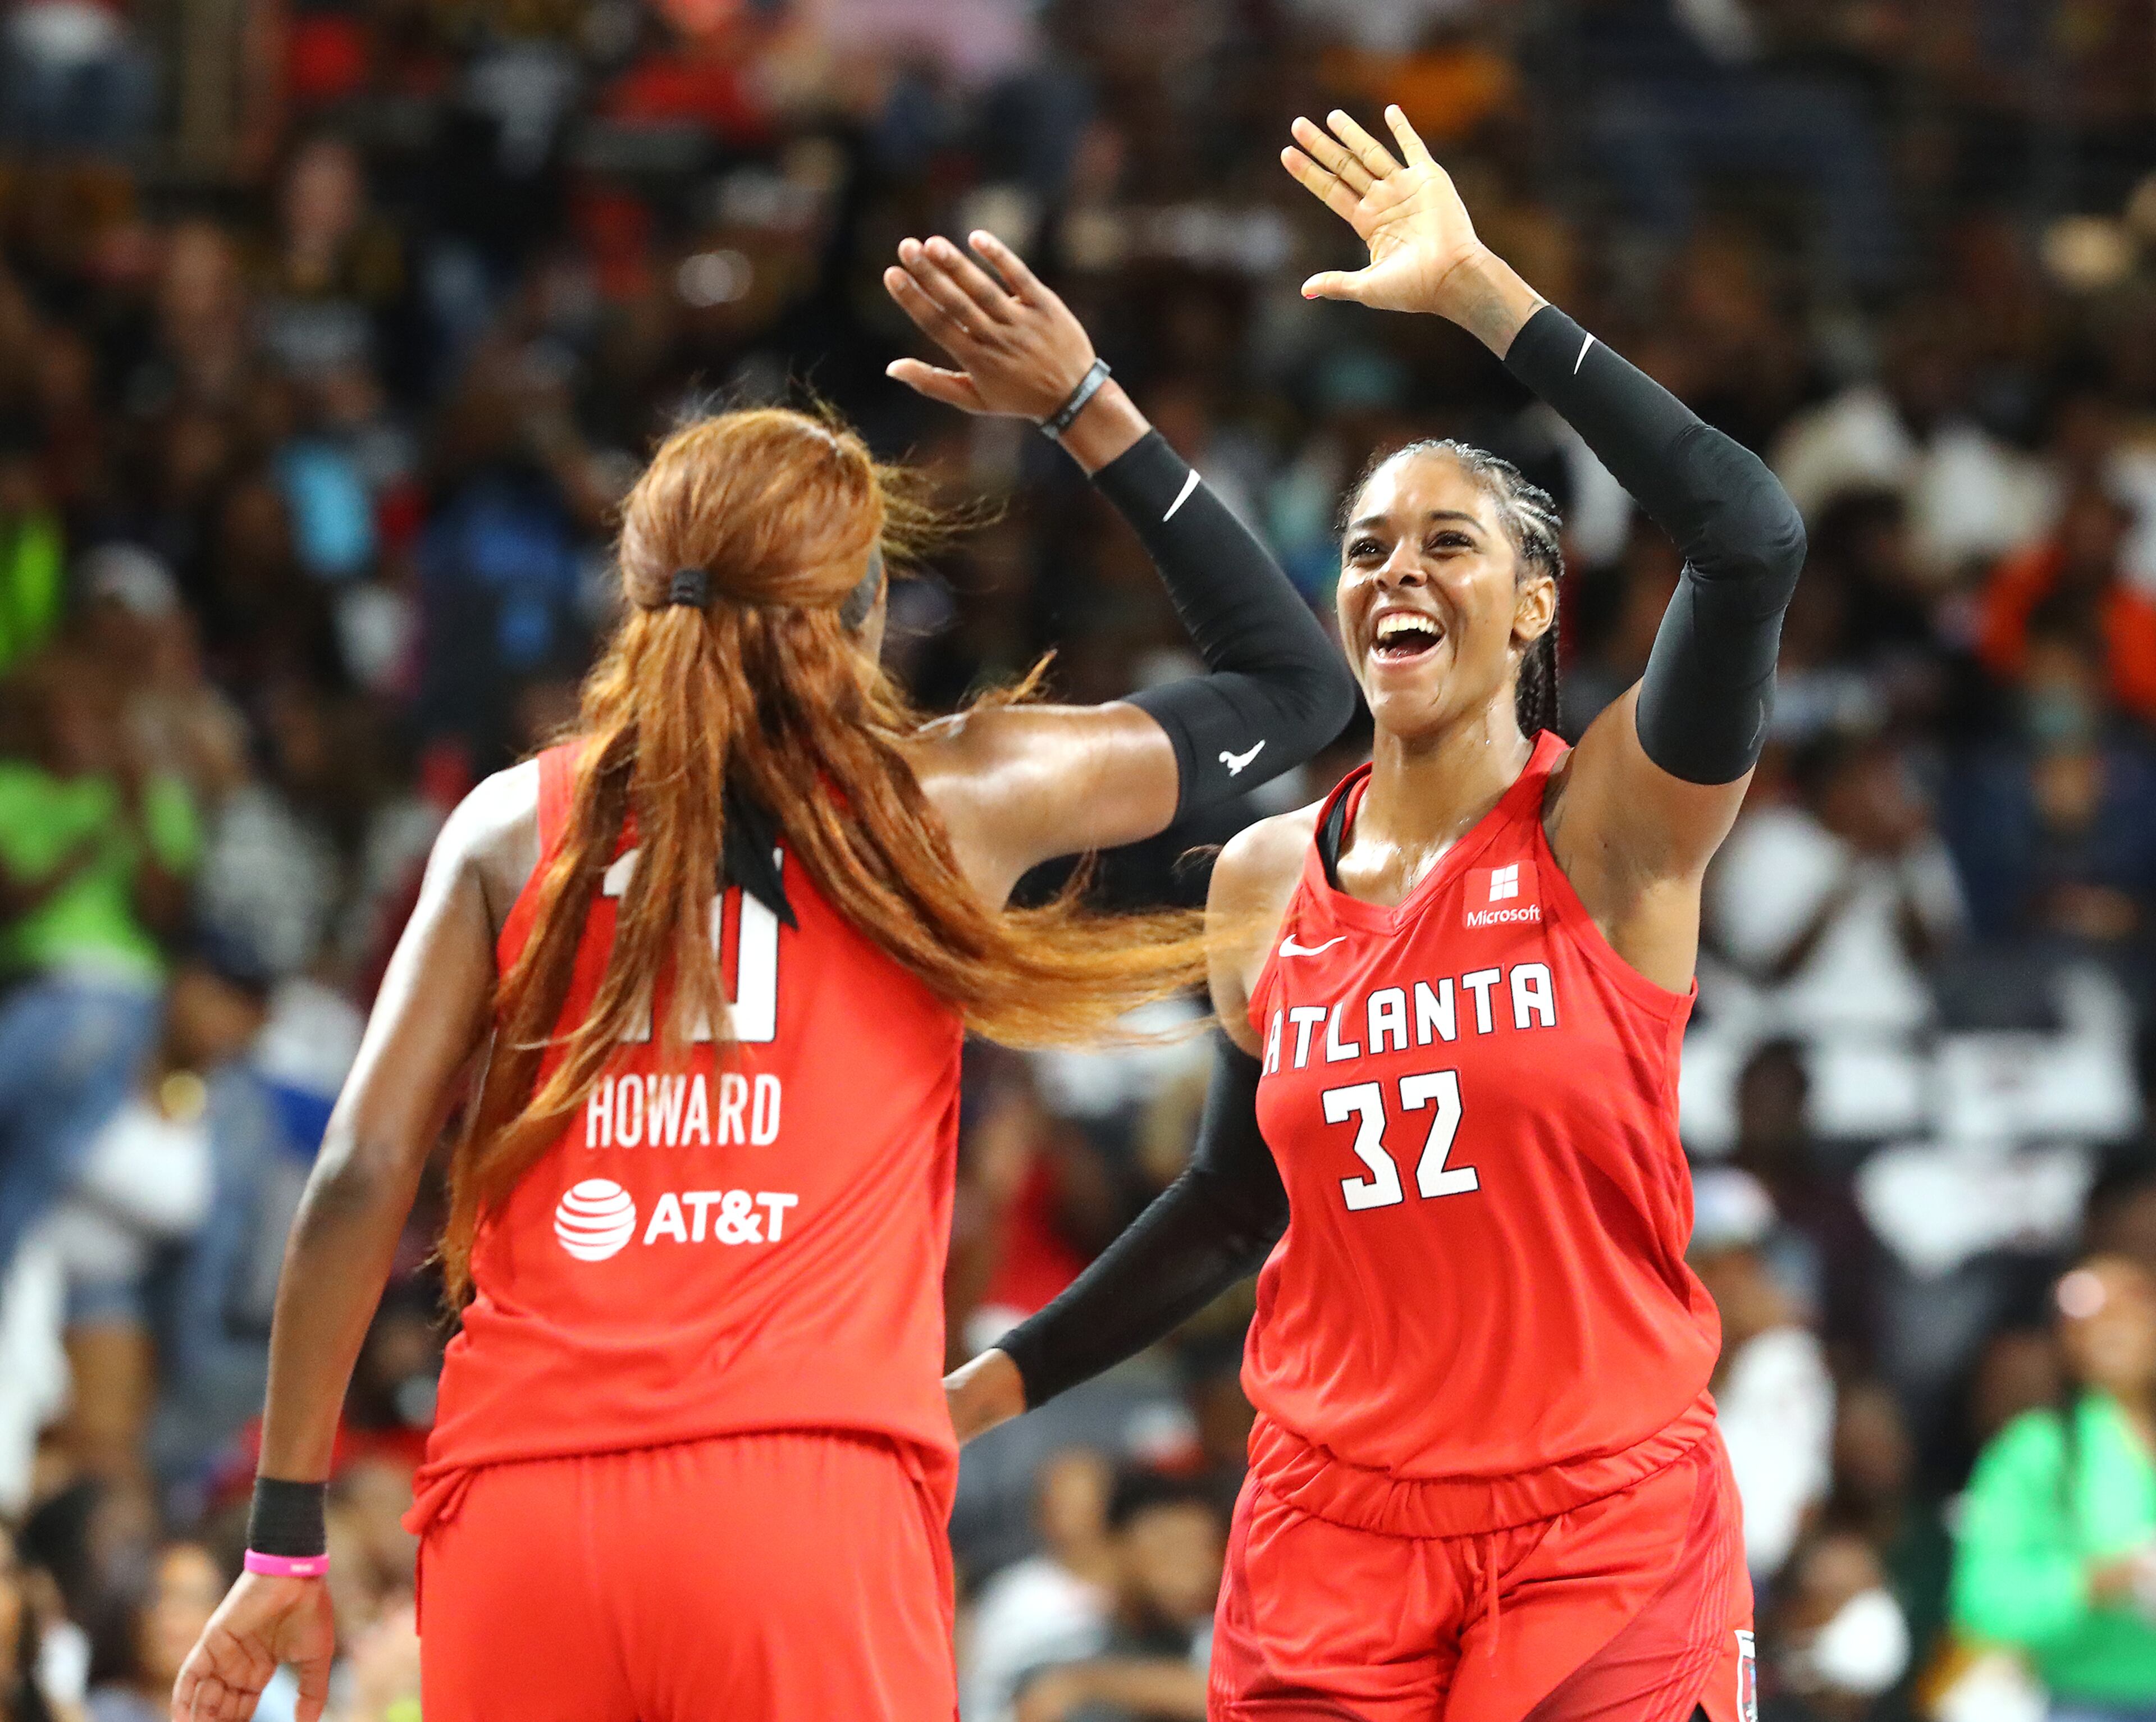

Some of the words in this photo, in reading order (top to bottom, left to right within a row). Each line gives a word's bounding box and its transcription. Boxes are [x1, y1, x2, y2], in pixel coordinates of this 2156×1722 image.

[1467, 904, 1541, 927] Microsoft
[1262, 962, 1556, 1077] ATLANTA
[586, 1073, 781, 1148] HOWARD
[1322, 1069, 1479, 1211] 32
[643, 1189, 798, 1245] AT&T
